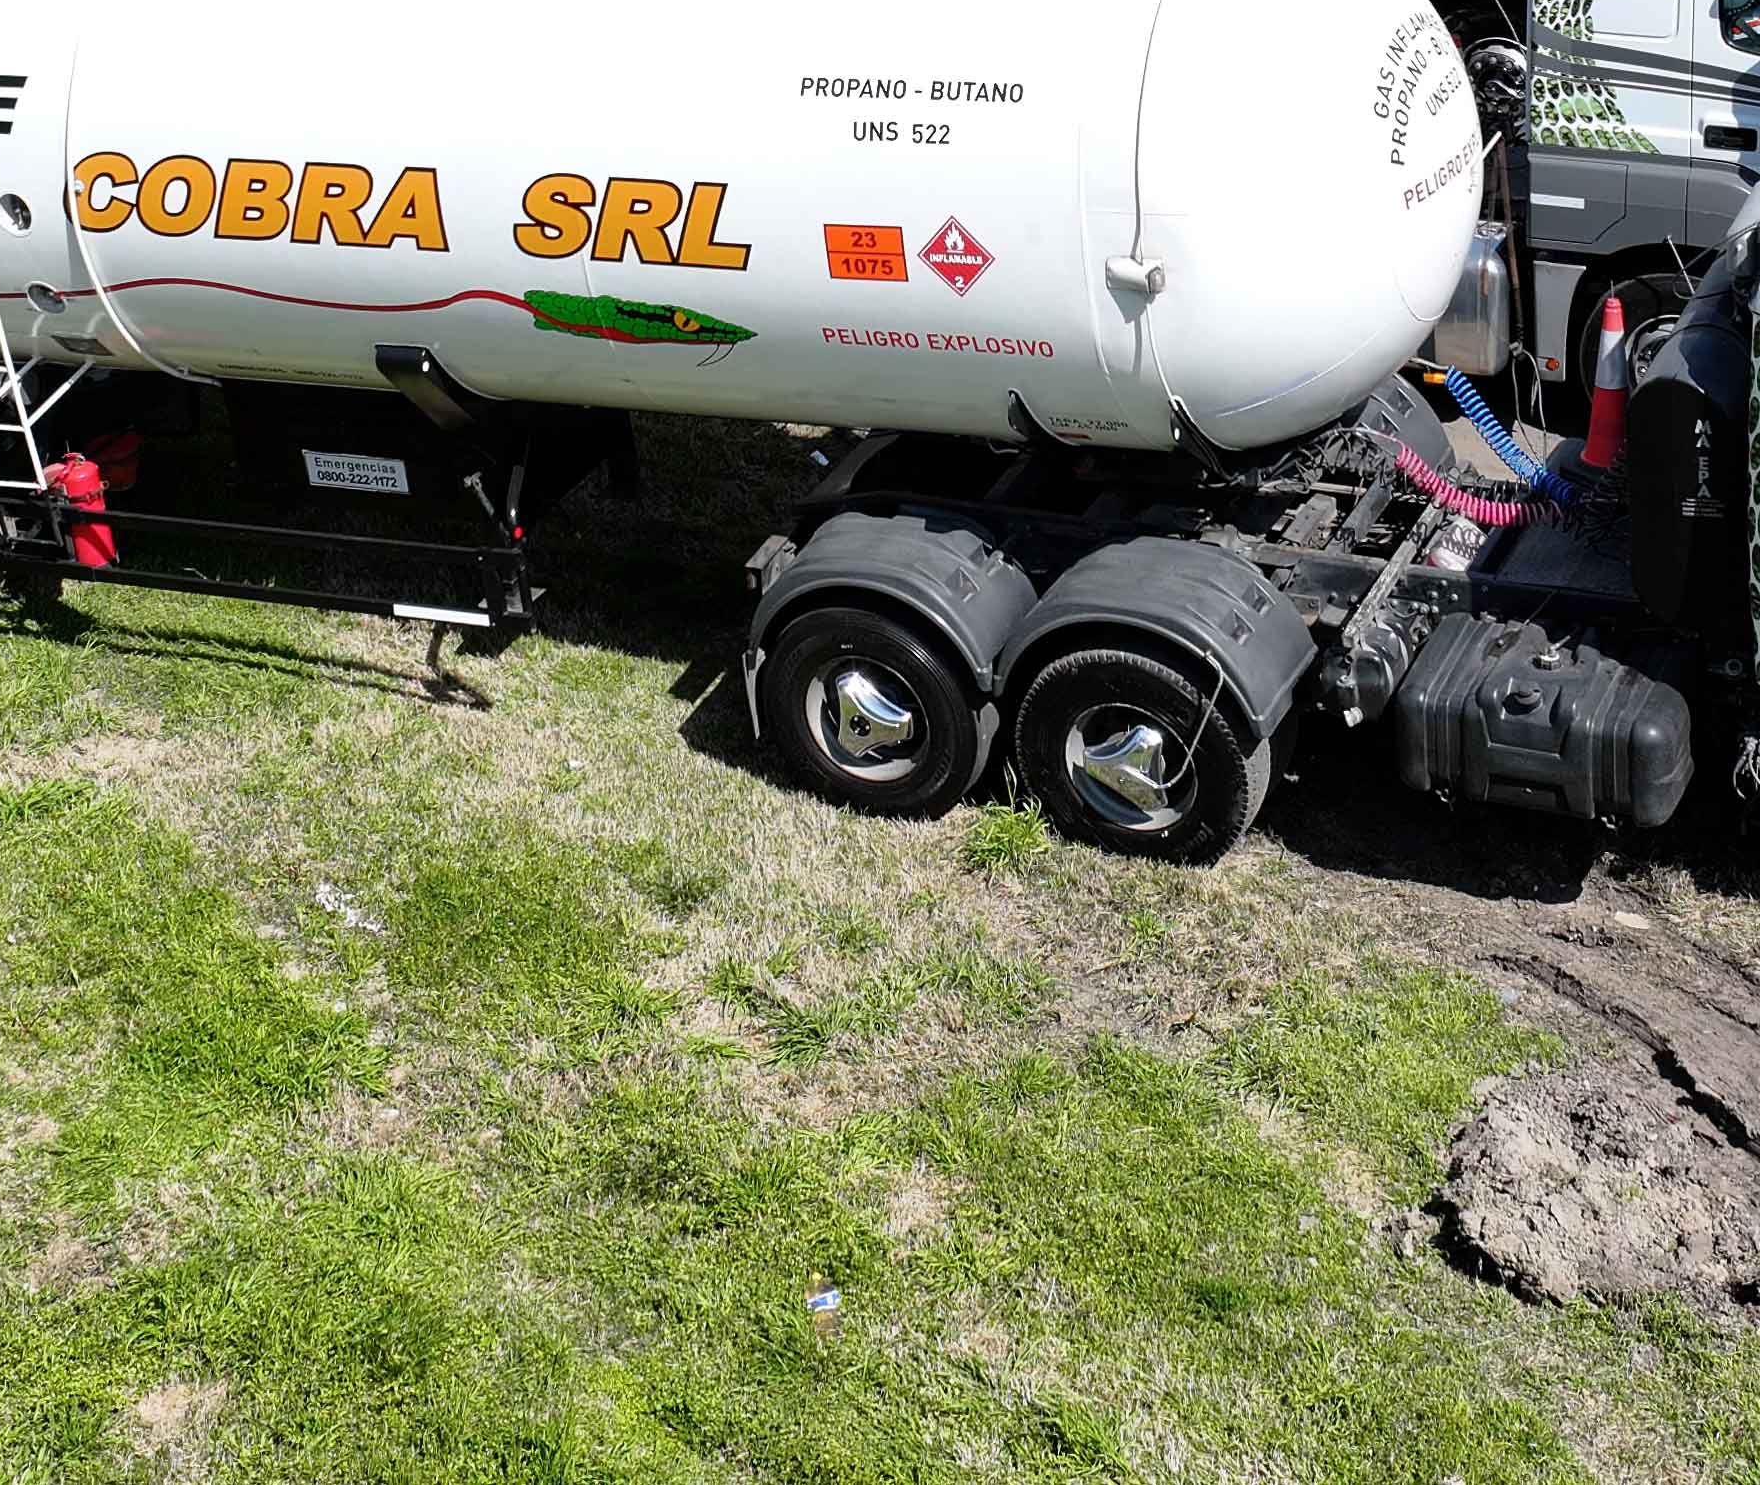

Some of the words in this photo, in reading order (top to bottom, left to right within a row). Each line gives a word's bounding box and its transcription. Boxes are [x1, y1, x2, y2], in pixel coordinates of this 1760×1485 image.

[800, 77, 907, 100] PROPANO
[930, 80, 1024, 103] BUTANO
[1373, 67, 1396, 119] GAS
[1390, 49, 1428, 166] PROPANO
[853, 121, 899, 142] UNS
[912, 123, 951, 145] 522
[1403, 152, 1462, 210] PELIGRO
[63, 152, 450, 253] COBRA
[514, 172, 752, 271] SRL
[850, 231, 877, 249] 23
[841, 258, 894, 276] 1075
[930, 253, 984, 265] INFLAMABLE
[954, 276, 965, 288] 2
[822, 327, 920, 349] PELIGRO
[927, 333, 1055, 358] EXPLOSIVO
[314, 456, 396, 474] Emergencias
[317, 470, 399, 488] 0800-222-1172
